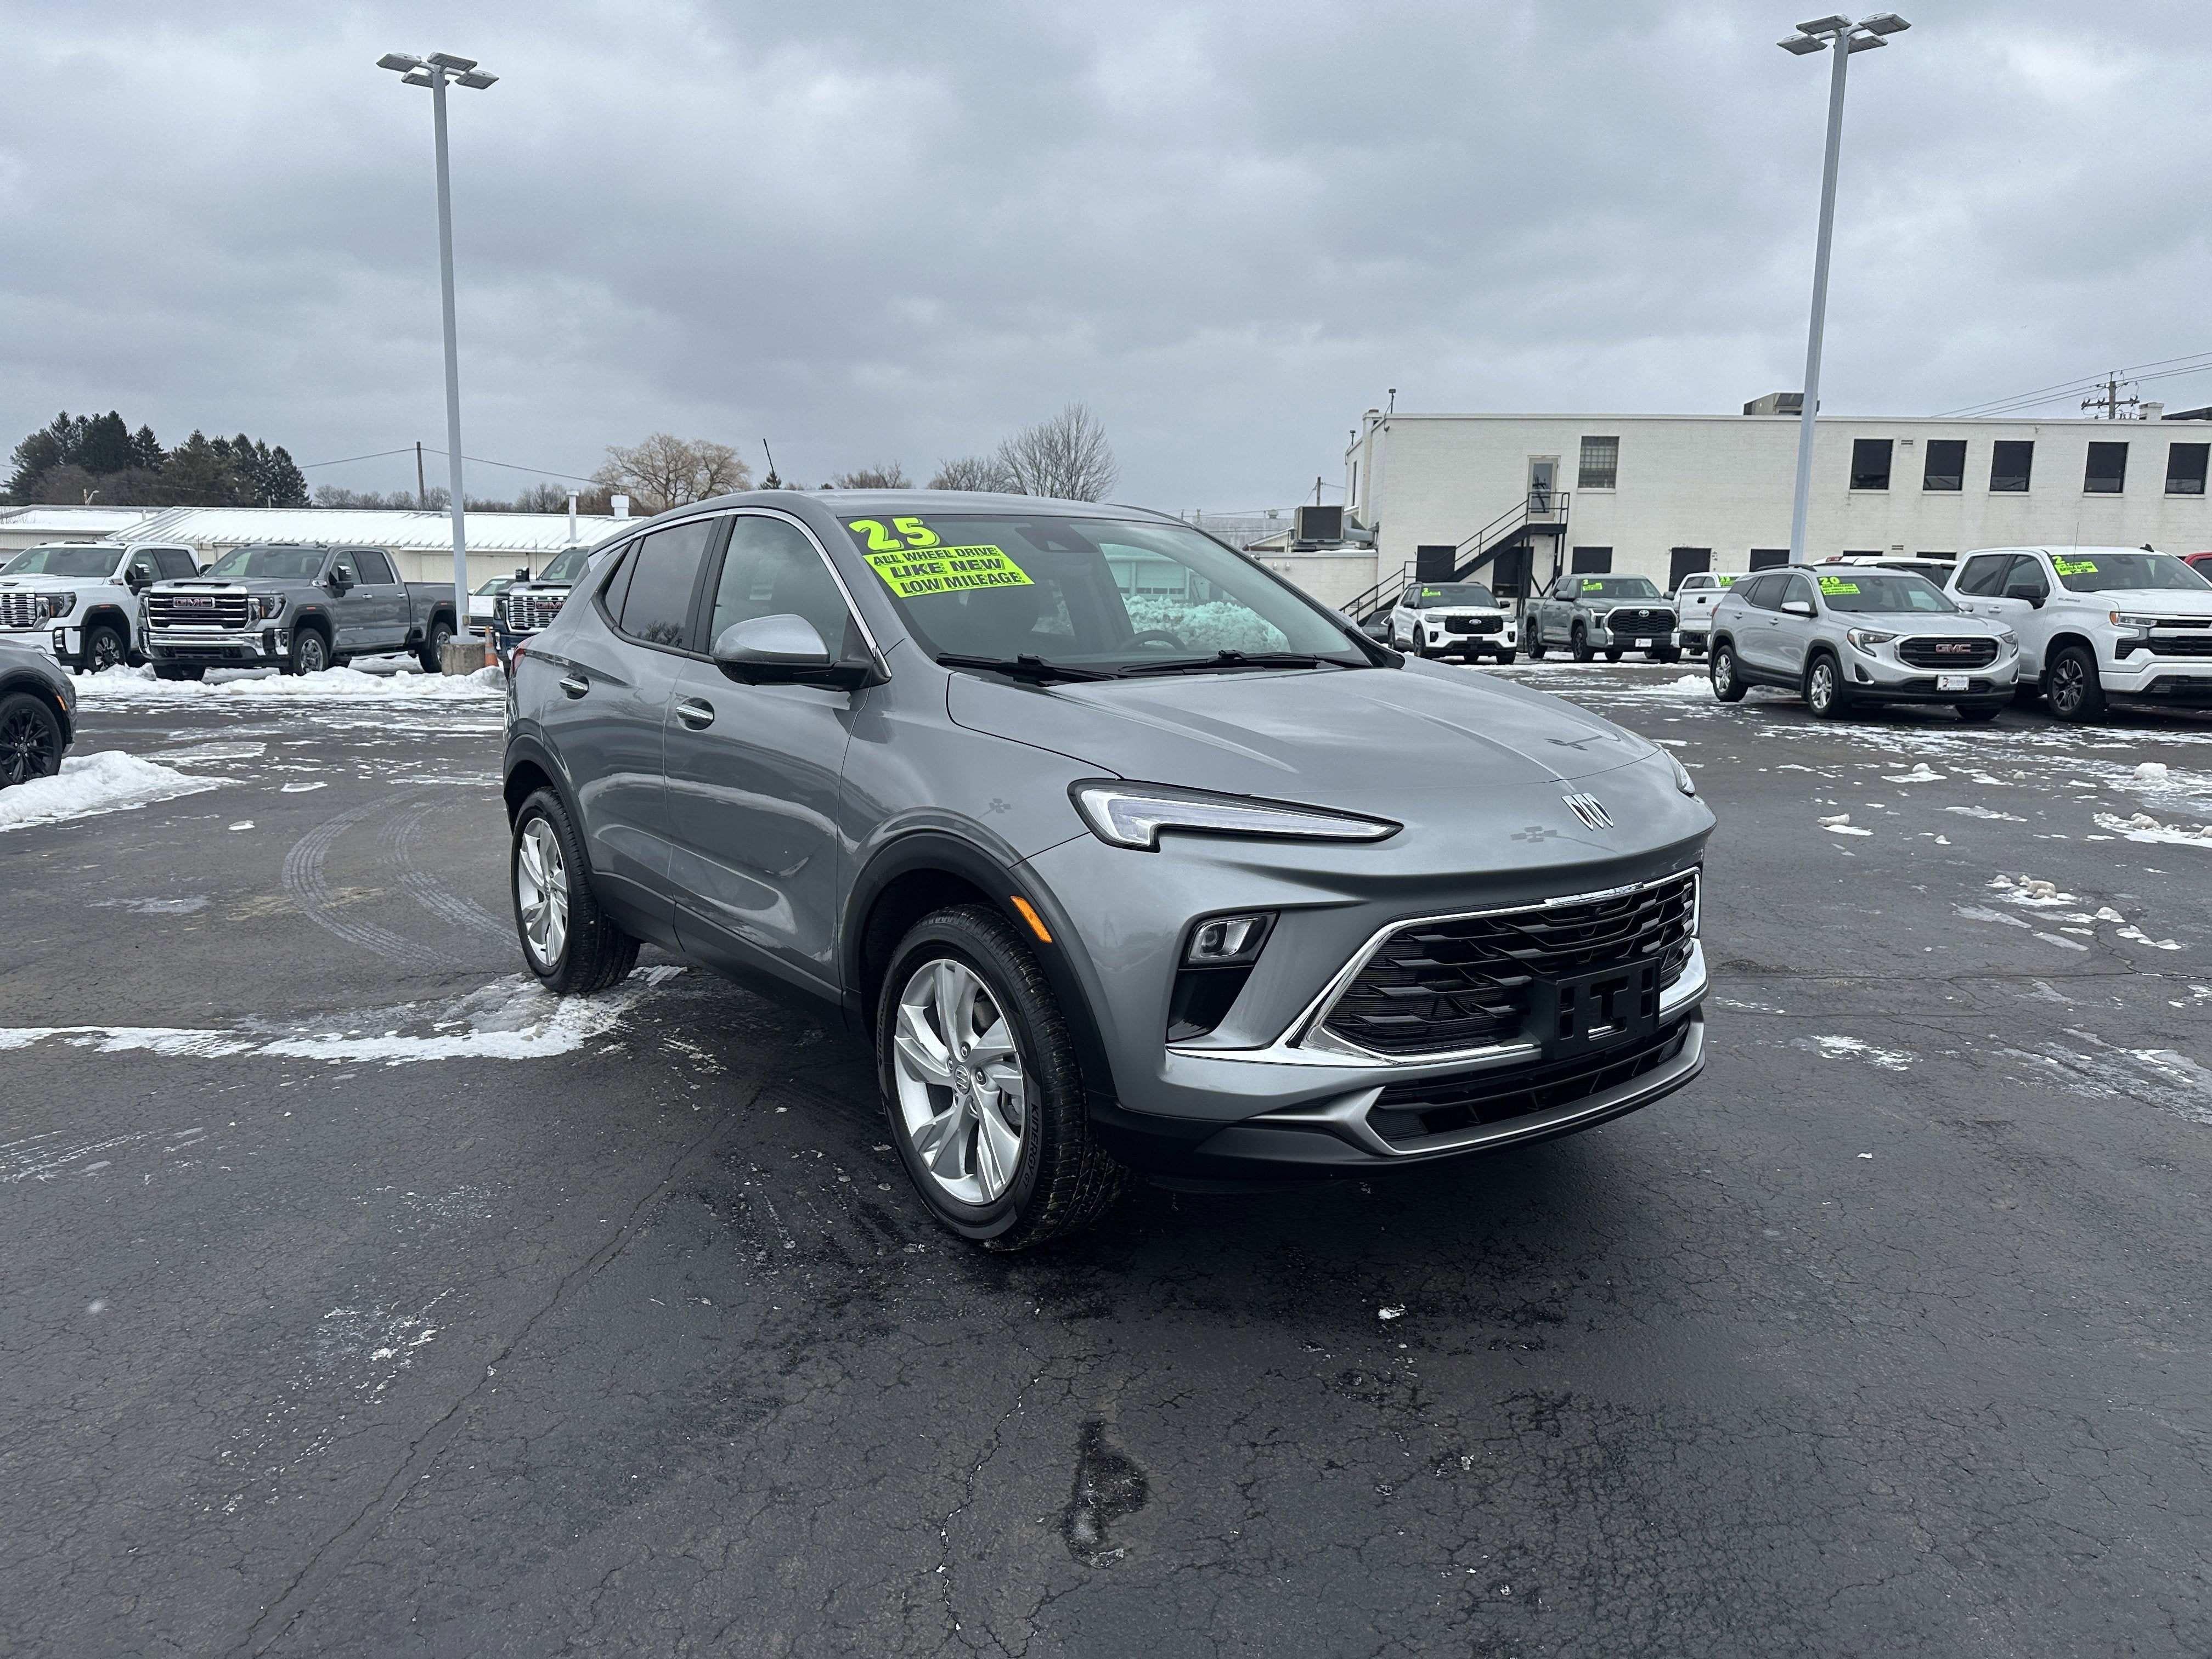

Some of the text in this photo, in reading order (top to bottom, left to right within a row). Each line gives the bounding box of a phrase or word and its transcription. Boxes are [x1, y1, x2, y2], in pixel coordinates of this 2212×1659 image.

[849, 517, 939, 551] 25
[873, 548, 999, 566] ALL WHEEL DRIVE
[890, 558, 1004, 579] LIKE NEW
[900, 572, 1024, 594] LOW MILEAGE
[1819, 577, 1841, 585] 20
[1936, 644, 1971, 653] GMC
[1028, 1103, 1039, 1175] KINERGY
